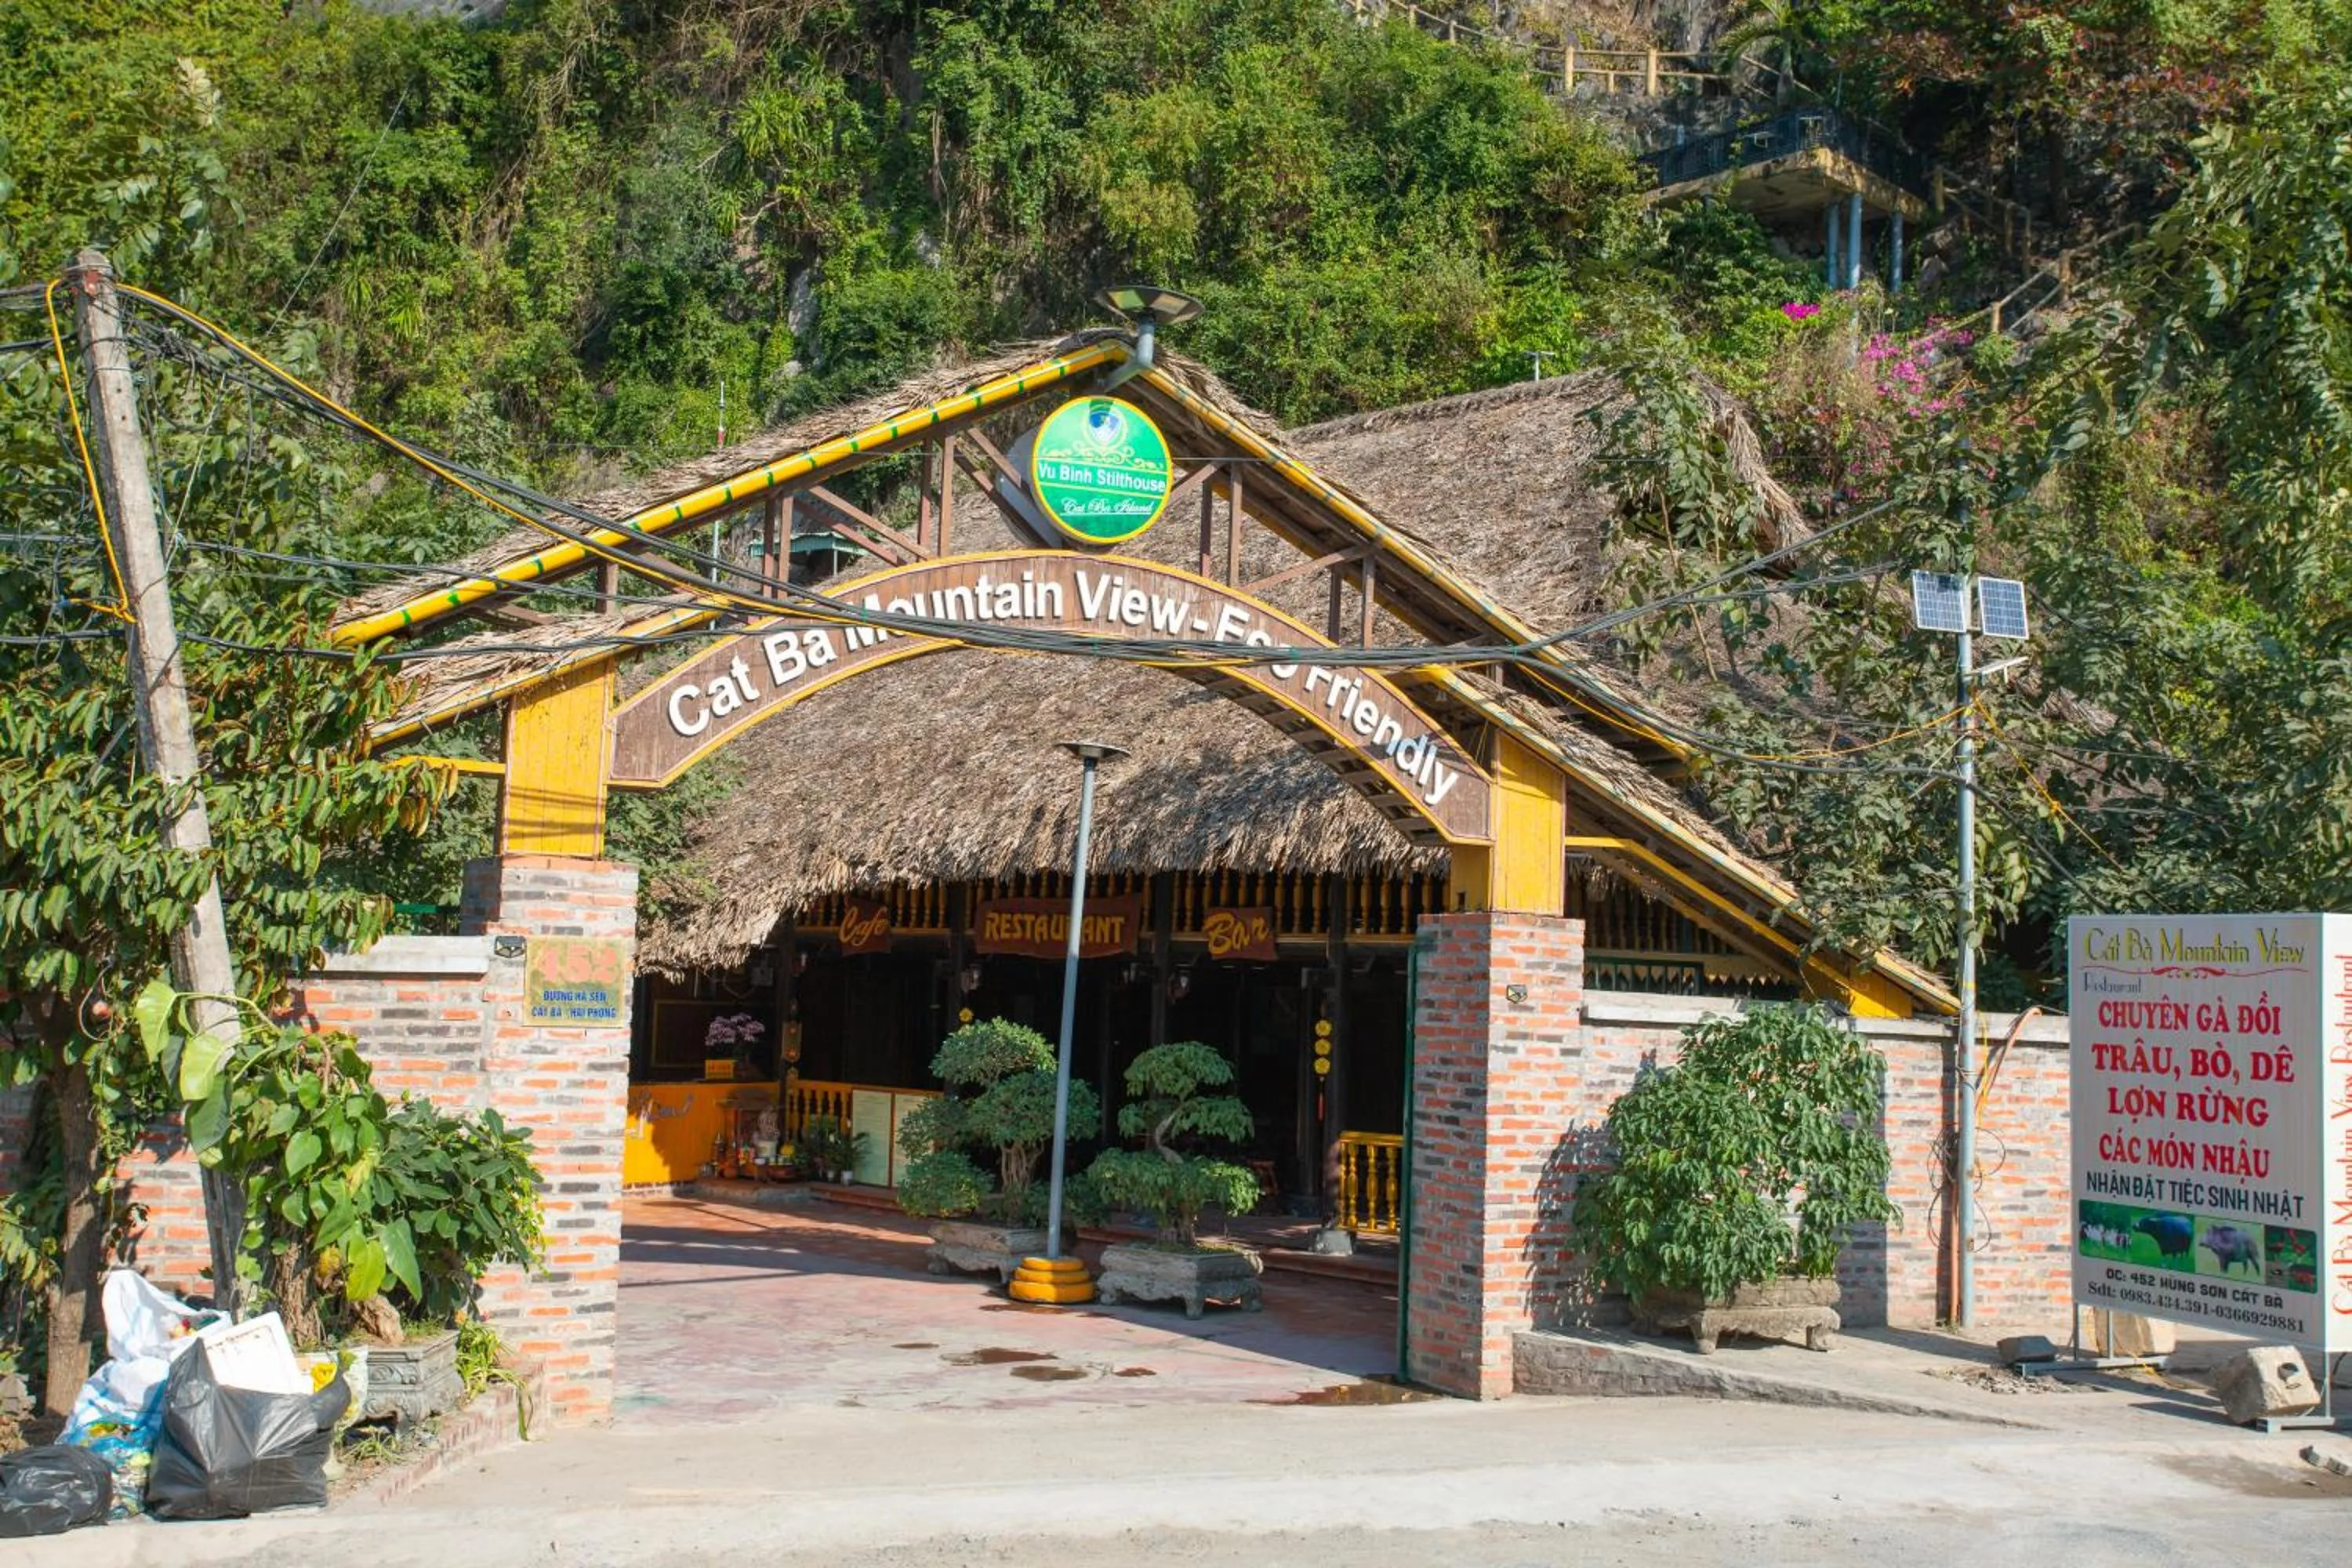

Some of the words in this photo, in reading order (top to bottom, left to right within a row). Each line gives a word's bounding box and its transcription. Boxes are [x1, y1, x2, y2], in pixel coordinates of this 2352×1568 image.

[1039, 462, 1056, 478] Vu
[1060, 464, 1092, 483] Binh
[1097, 469, 1166, 492] Stilthouse
[667, 654, 760, 736] Cat
[763, 627, 837, 686] Ba
[985, 910, 1125, 944] RESTAUANT
[1204, 912, 1269, 954] Bar
[2160, 928, 2250, 964] Mountain
[2256, 928, 2305, 964] View
[2098, 994, 2189, 1030] CHUYÊN
[2196, 996, 2230, 1033] GÀ
[2238, 991, 2281, 1036] ĐỒI
[2092, 1037, 2181, 1080] TRÂU,
[2190, 1041, 2240, 1085] BÒ,
[2250, 1044, 2295, 1083] DÊ
[2107, 1085, 2166, 1123] LỢN
[2176, 1086, 2269, 1127] RỪNG
[2099, 1127, 2141, 1164] CÁC
[2147, 1132, 2195, 1170] MÓN
[2202, 1138, 2270, 1184] NHẬU
[2086, 1170, 2130, 1198] NHẬN
[2169, 1178, 2204, 1208] TIỆC
[2209, 1186, 2249, 1211] SINH
[2253, 1189, 2304, 1221] NHẬT
[2130, 1272, 2155, 1287] 452
